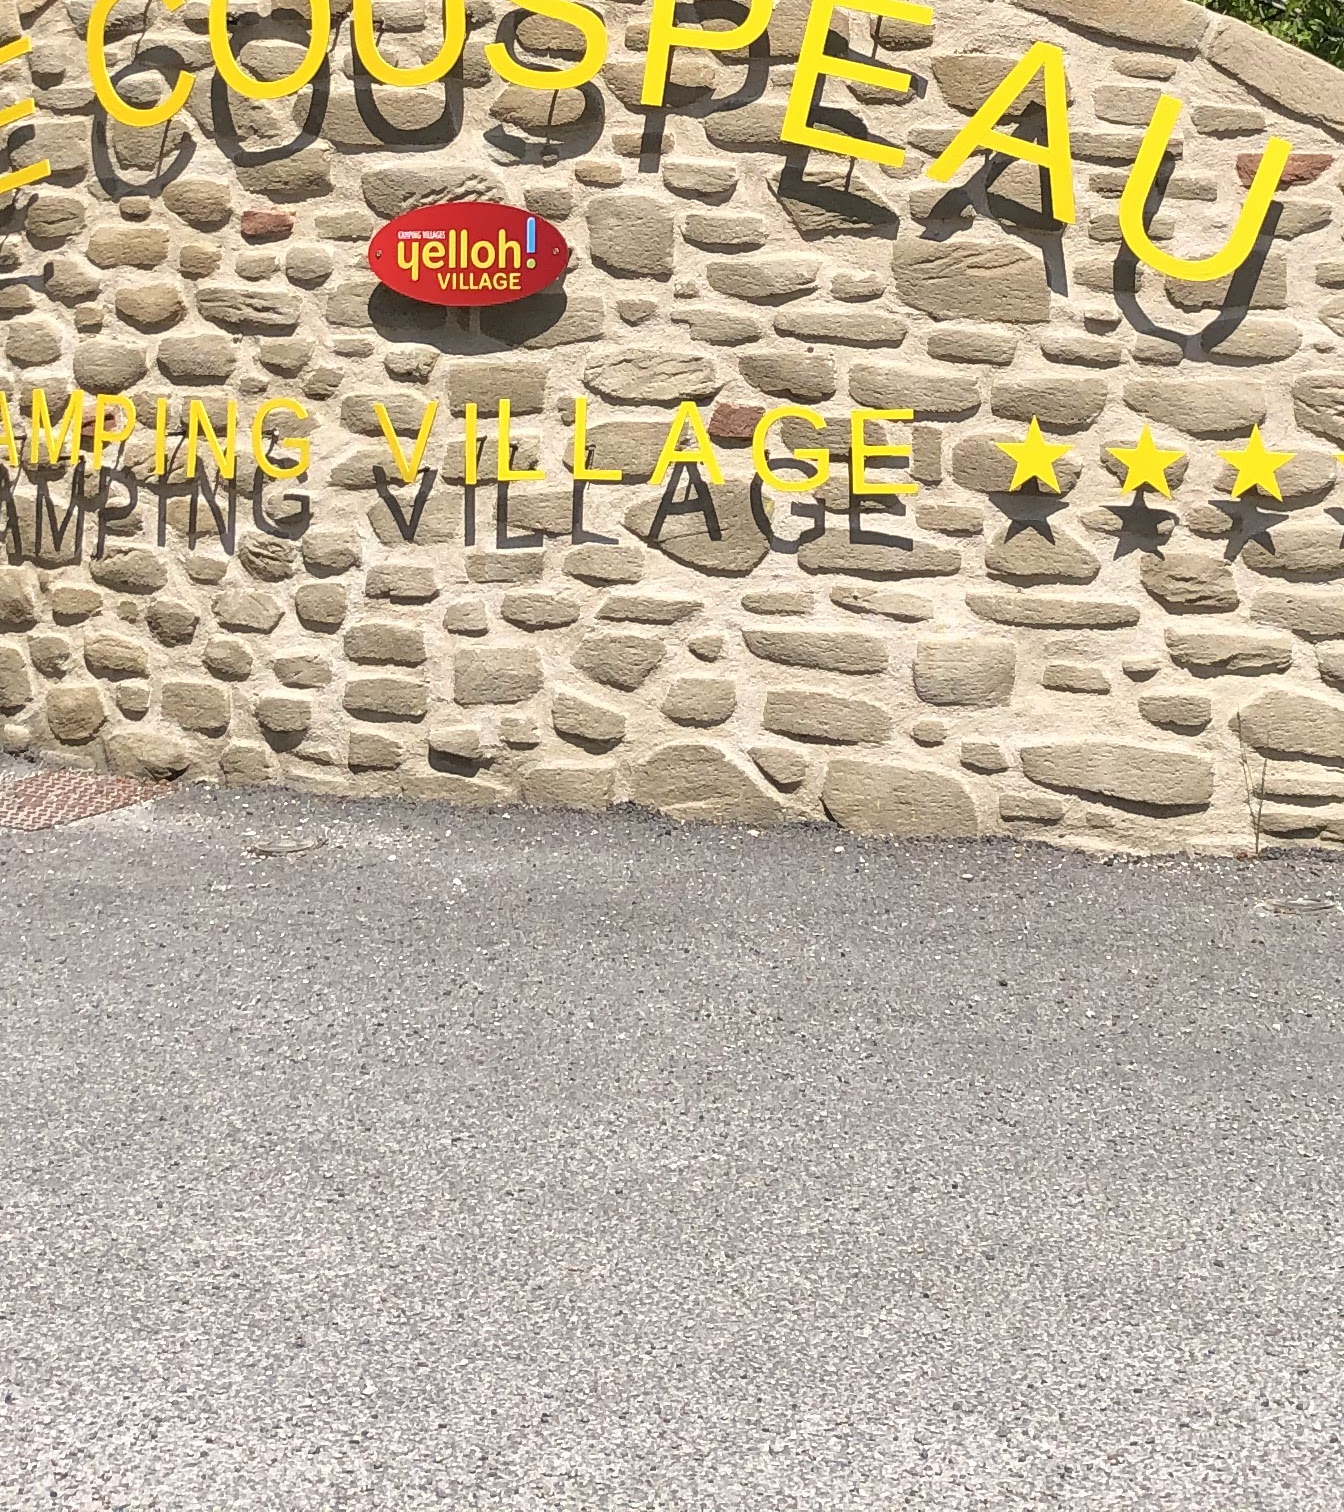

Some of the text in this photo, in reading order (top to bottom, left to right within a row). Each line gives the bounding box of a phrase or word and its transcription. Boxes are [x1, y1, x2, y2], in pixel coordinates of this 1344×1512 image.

[397, 216, 536, 282] yelloh!
[437, 272, 522, 290] VILLAGE
[373, 397, 920, 496] VILLAGE
